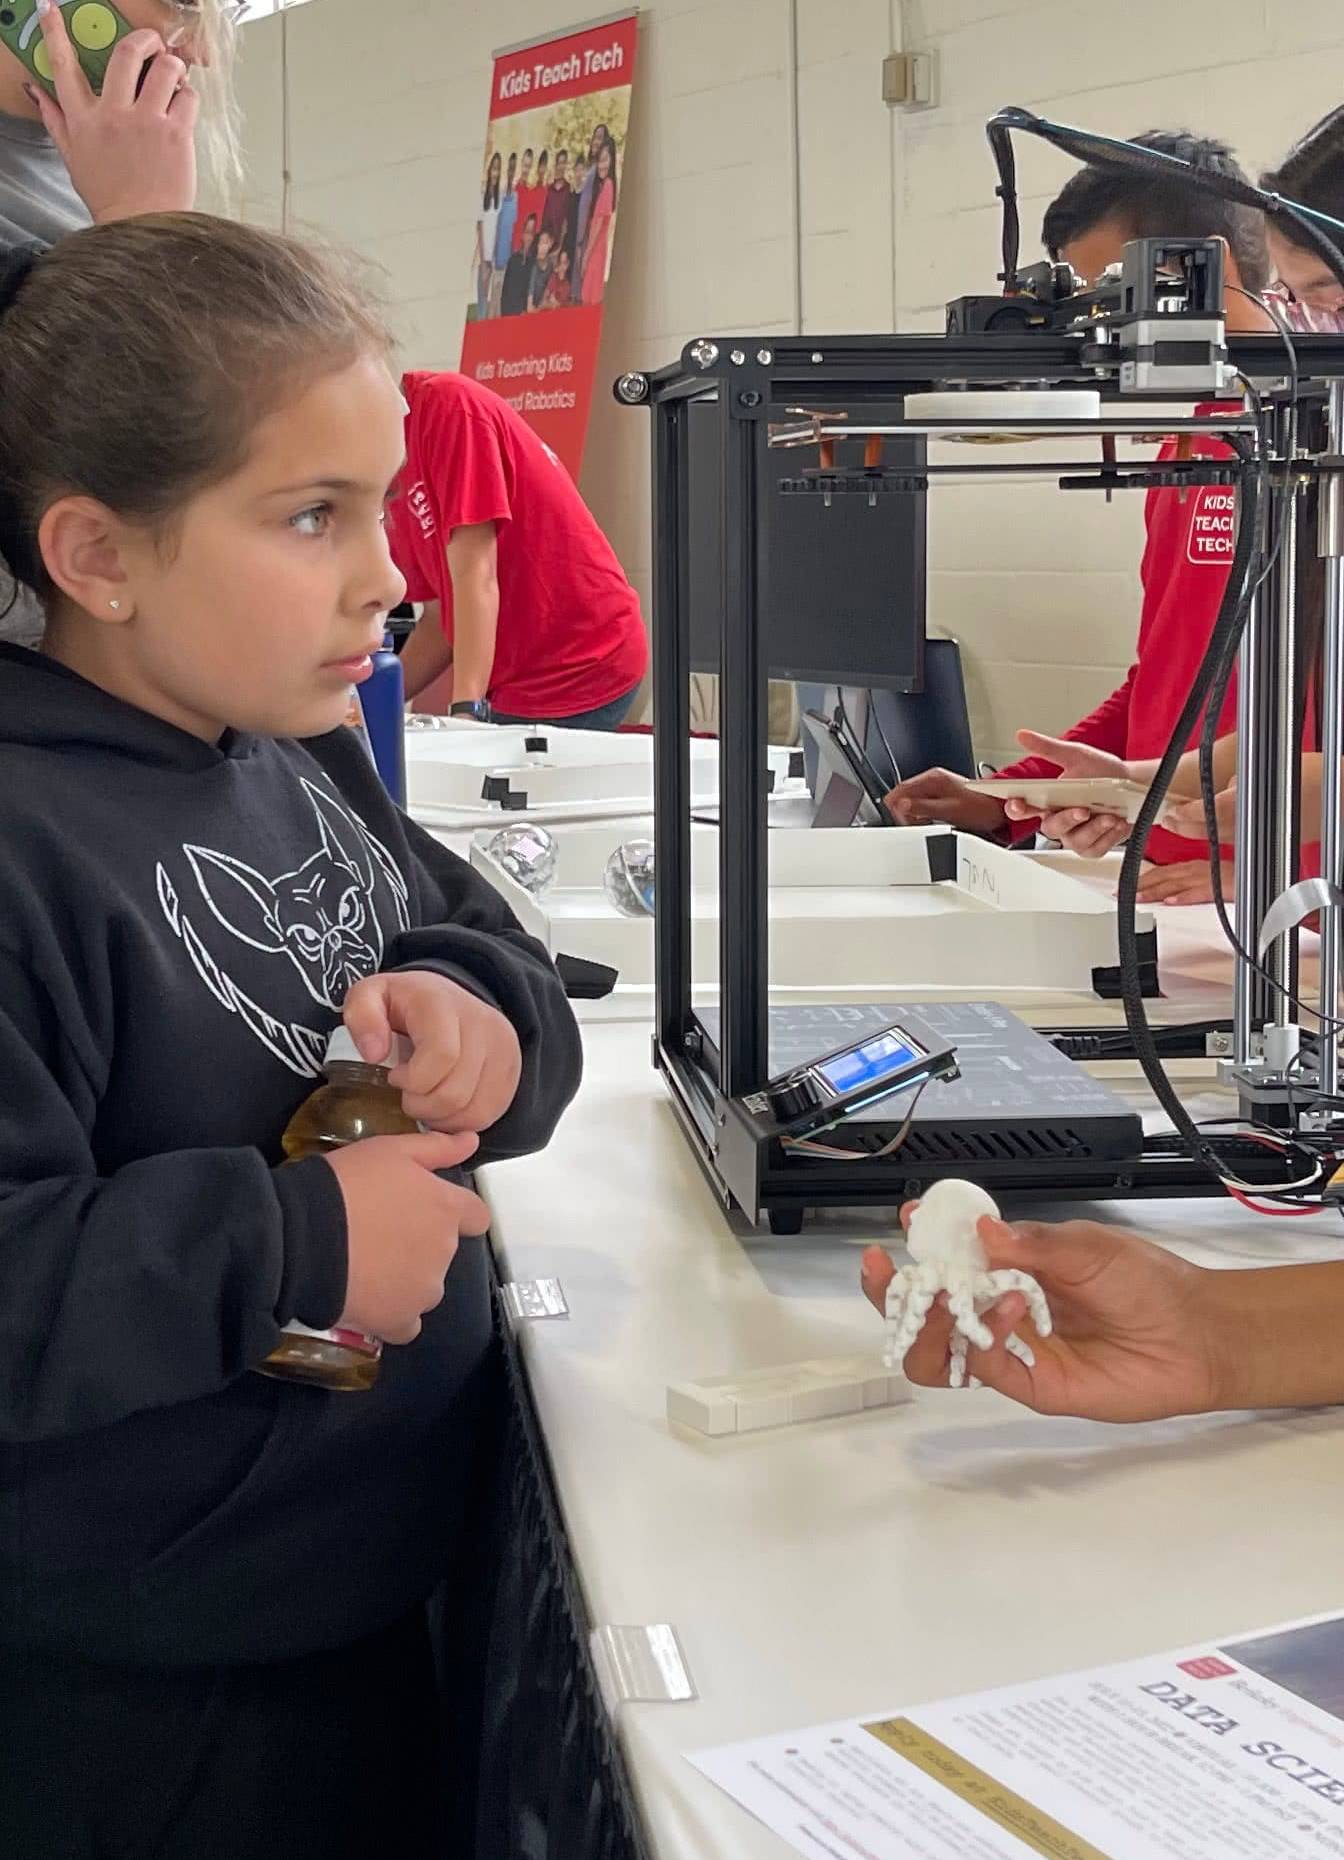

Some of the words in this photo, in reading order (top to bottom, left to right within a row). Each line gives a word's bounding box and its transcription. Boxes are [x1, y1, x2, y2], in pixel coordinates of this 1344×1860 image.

[499, 69, 531, 100] Kids
[534, 54, 581, 90] Teach
[584, 42, 624, 76] Tech
[497, 355, 547, 381] Teaching
[547, 353, 573, 373] Kids
[525, 389, 576, 410] Robotics
[1204, 496, 1235, 510] KIDS
[1138, 1681, 1240, 1736] DATA
